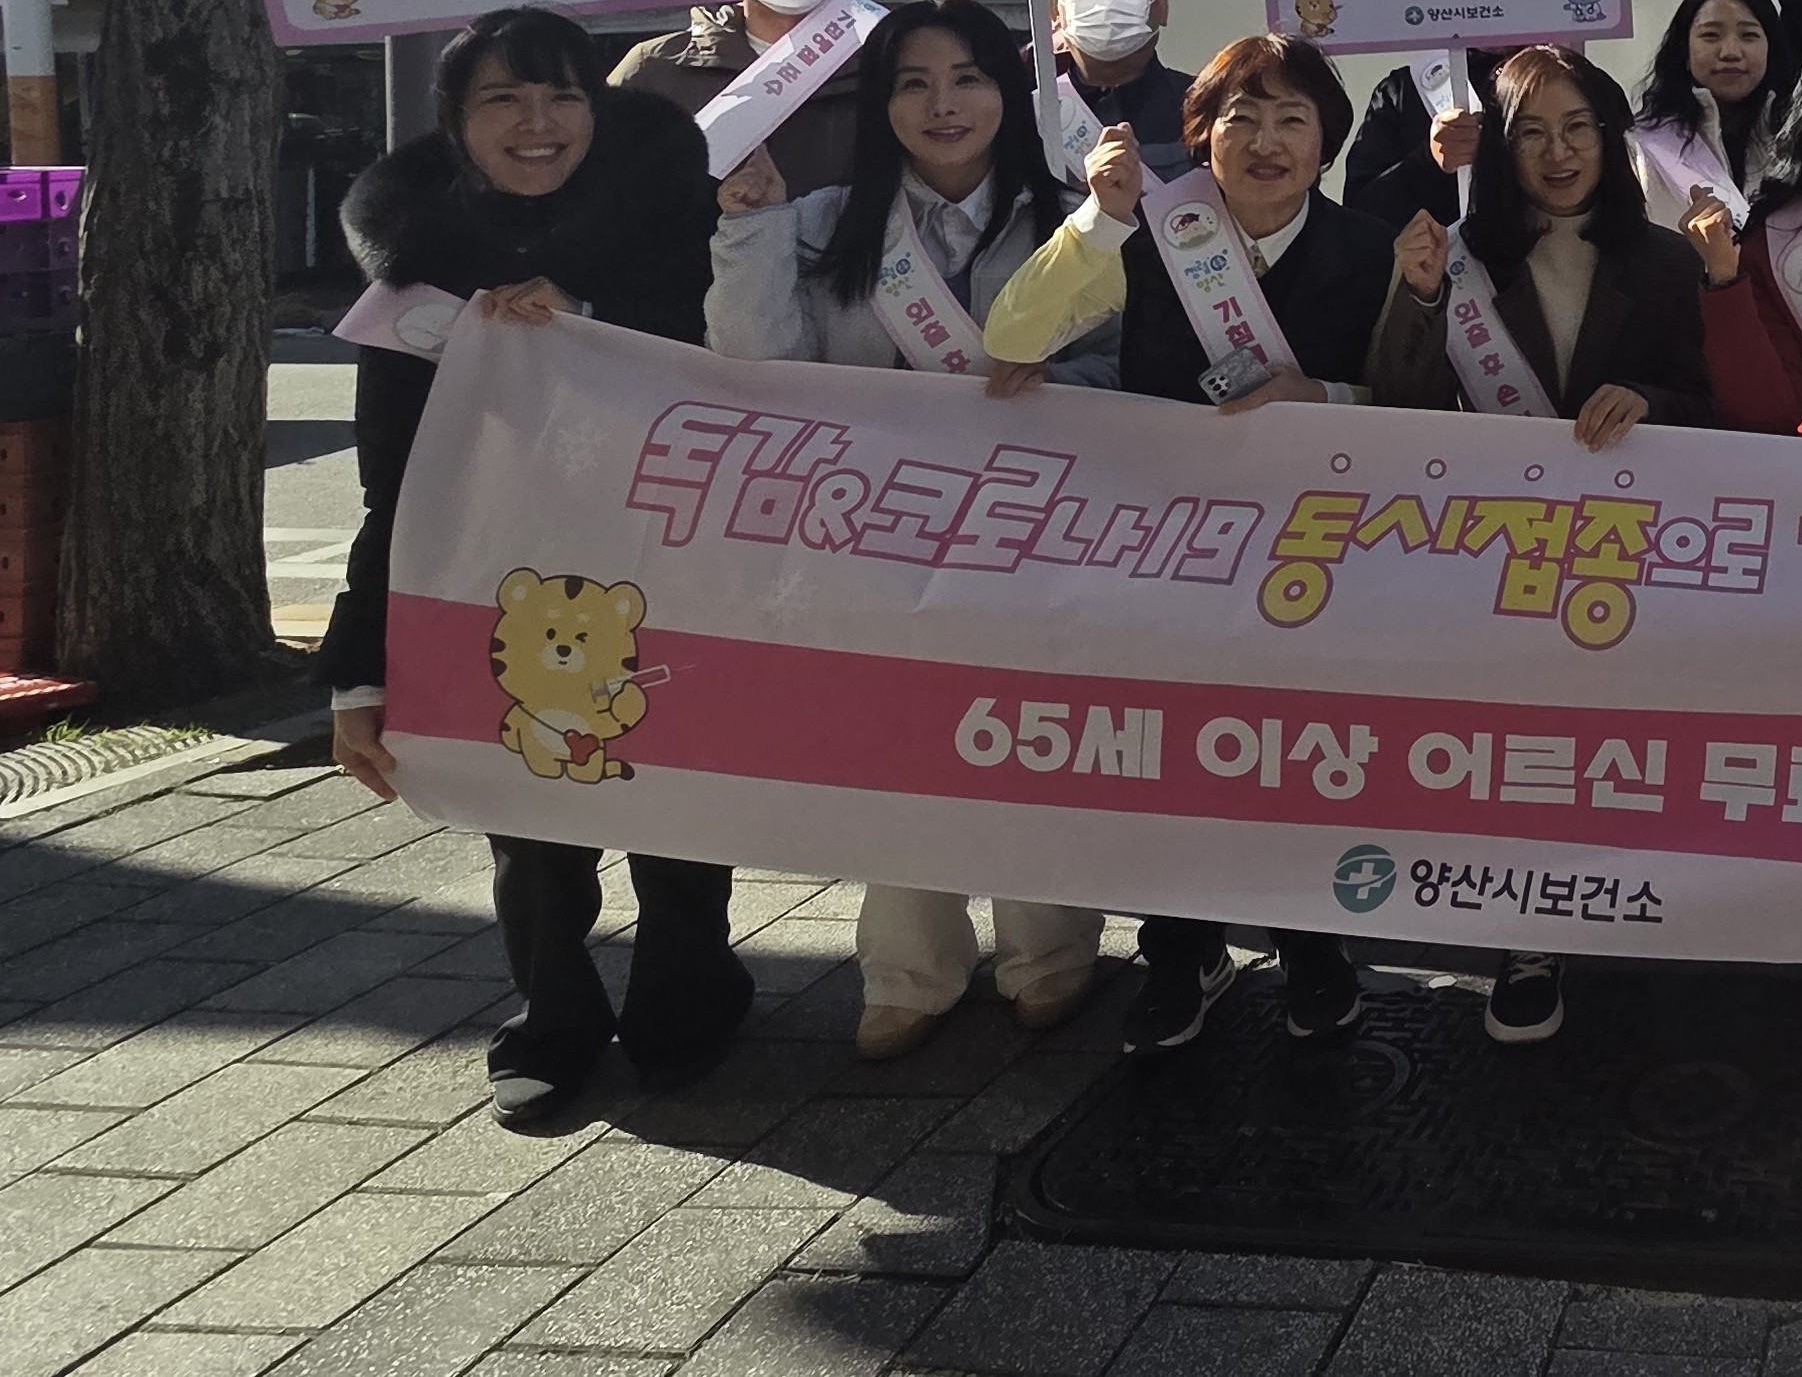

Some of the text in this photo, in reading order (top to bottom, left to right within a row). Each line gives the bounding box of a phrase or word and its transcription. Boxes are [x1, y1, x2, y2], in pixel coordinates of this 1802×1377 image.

[1427, 5, 1504, 22] 양산시보건소
[905, 296, 972, 374] 외출 후
[1454, 298, 1492, 349] 외출
[1478, 352, 1505, 377] 후
[626, 400, 1265, 586] 독감&코로나19
[1257, 490, 1774, 651] 동시접종으로
[954, 698, 1162, 781] 65세
[1195, 714, 1379, 801] 이상
[1406, 730, 1668, 813] 어르신
[1409, 858, 1664, 925] 양산시보건소
